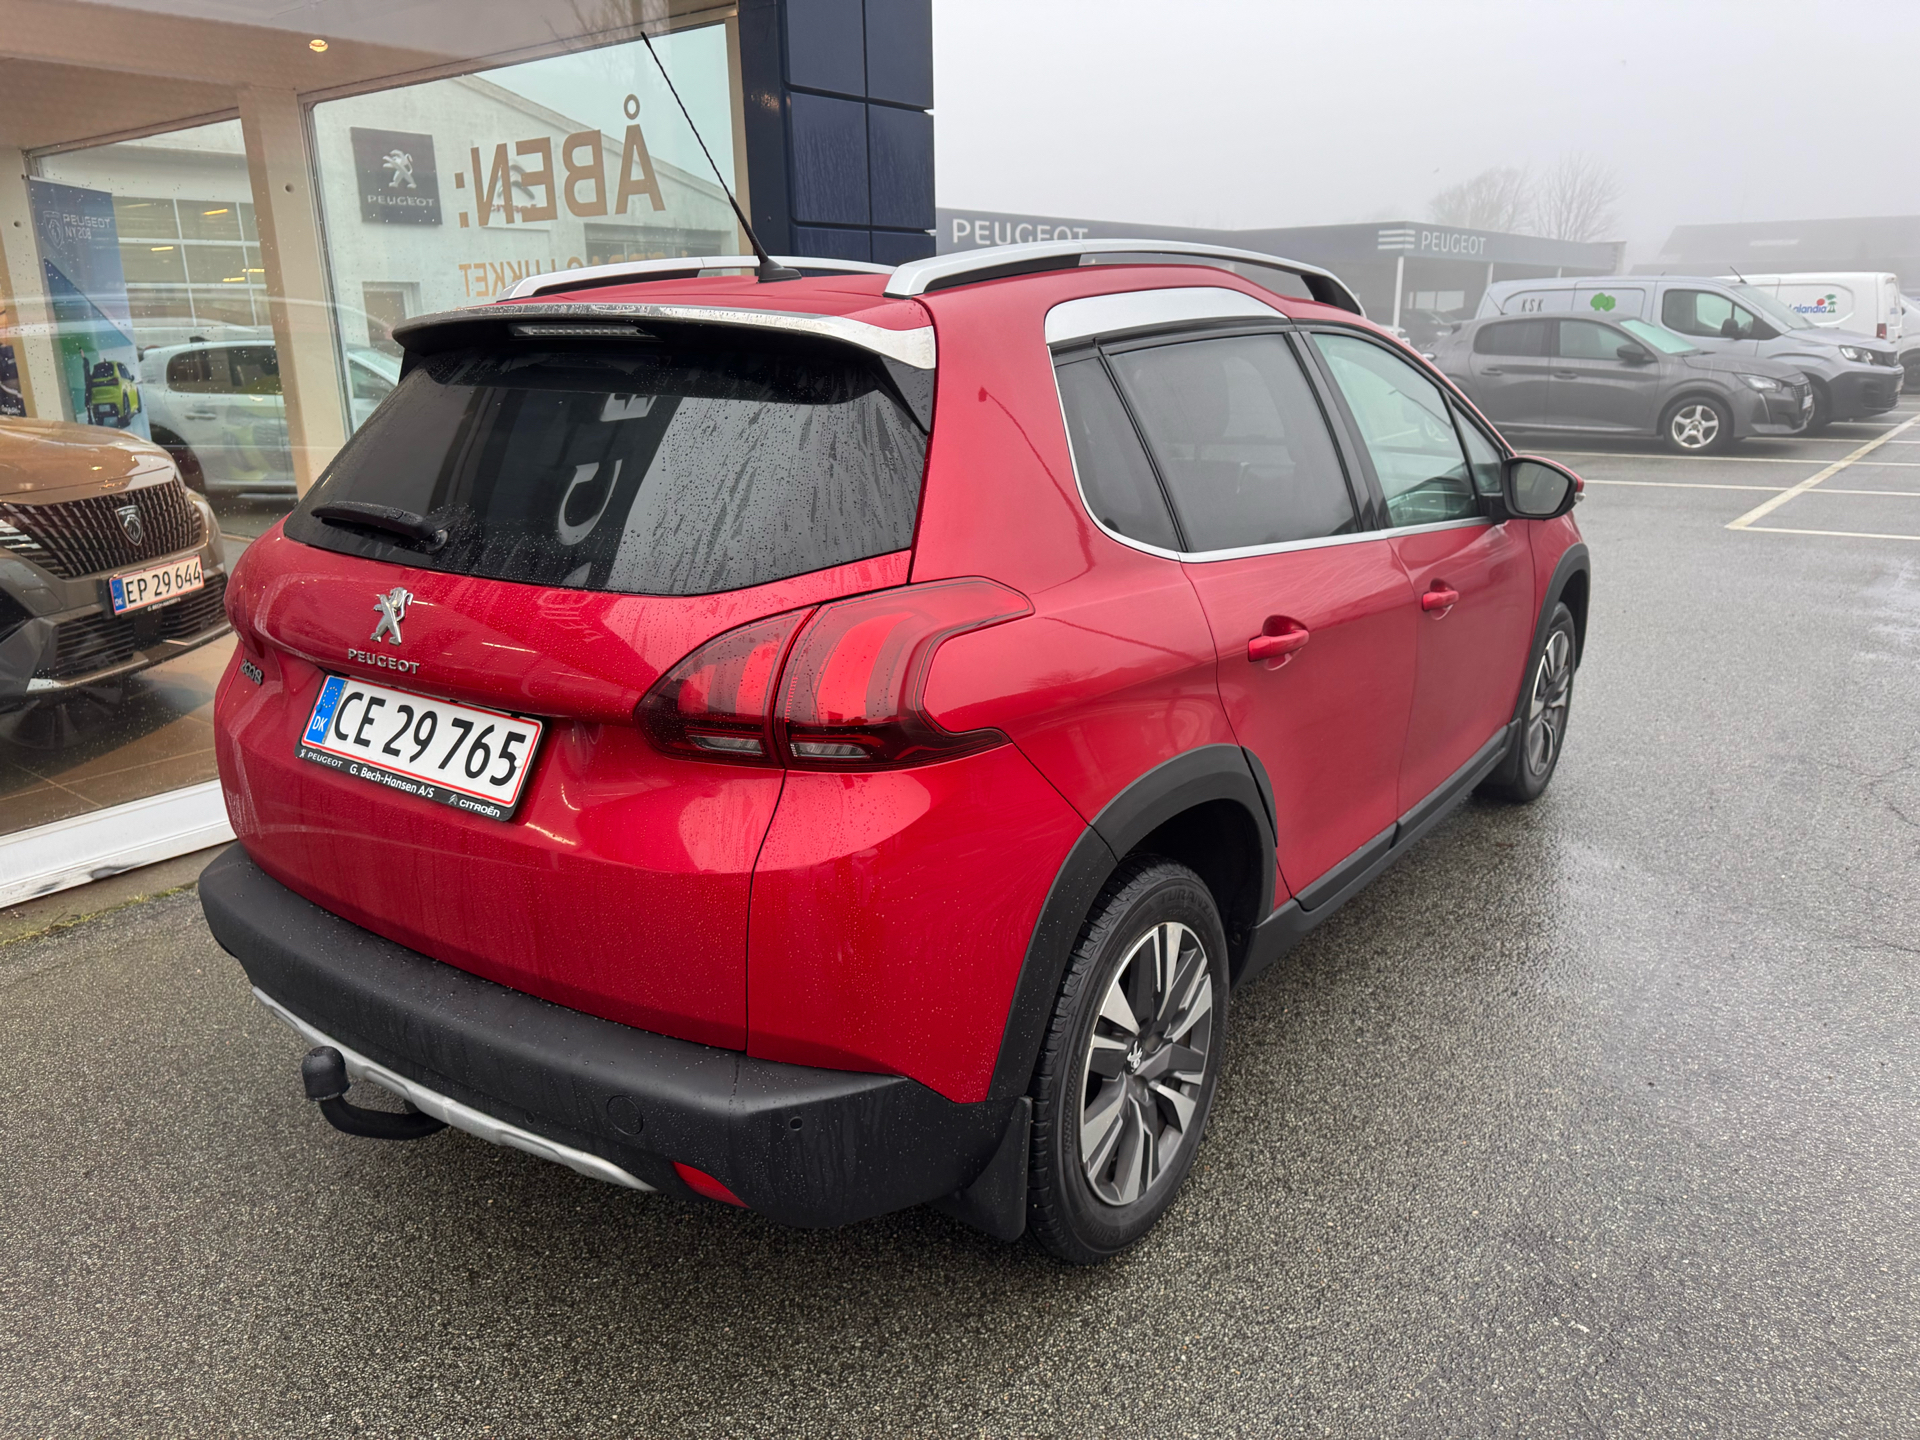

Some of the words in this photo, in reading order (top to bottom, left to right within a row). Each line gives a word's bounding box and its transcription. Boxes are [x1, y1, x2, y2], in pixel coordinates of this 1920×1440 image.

[367, 194, 435, 206] PEUGEOT
[63, 213, 110, 229] PEUGEOT
[1420, 230, 1487, 254] PEUGEOT
[125, 577, 147, 604] EP
[151, 570, 171, 597] 29
[175, 561, 201, 590] 644
[347, 648, 420, 675] PEUGEOT
[311, 714, 328, 734] DK
[333, 691, 386, 749] CE
[382, 704, 438, 764] 29
[437, 717, 527, 787] 765
[307, 751, 343, 769] PEUGEOT
[349, 763, 360, 777] G.
[361, 767, 417, 793] Bech-Hansen
[417, 785, 435, 799] A/S
